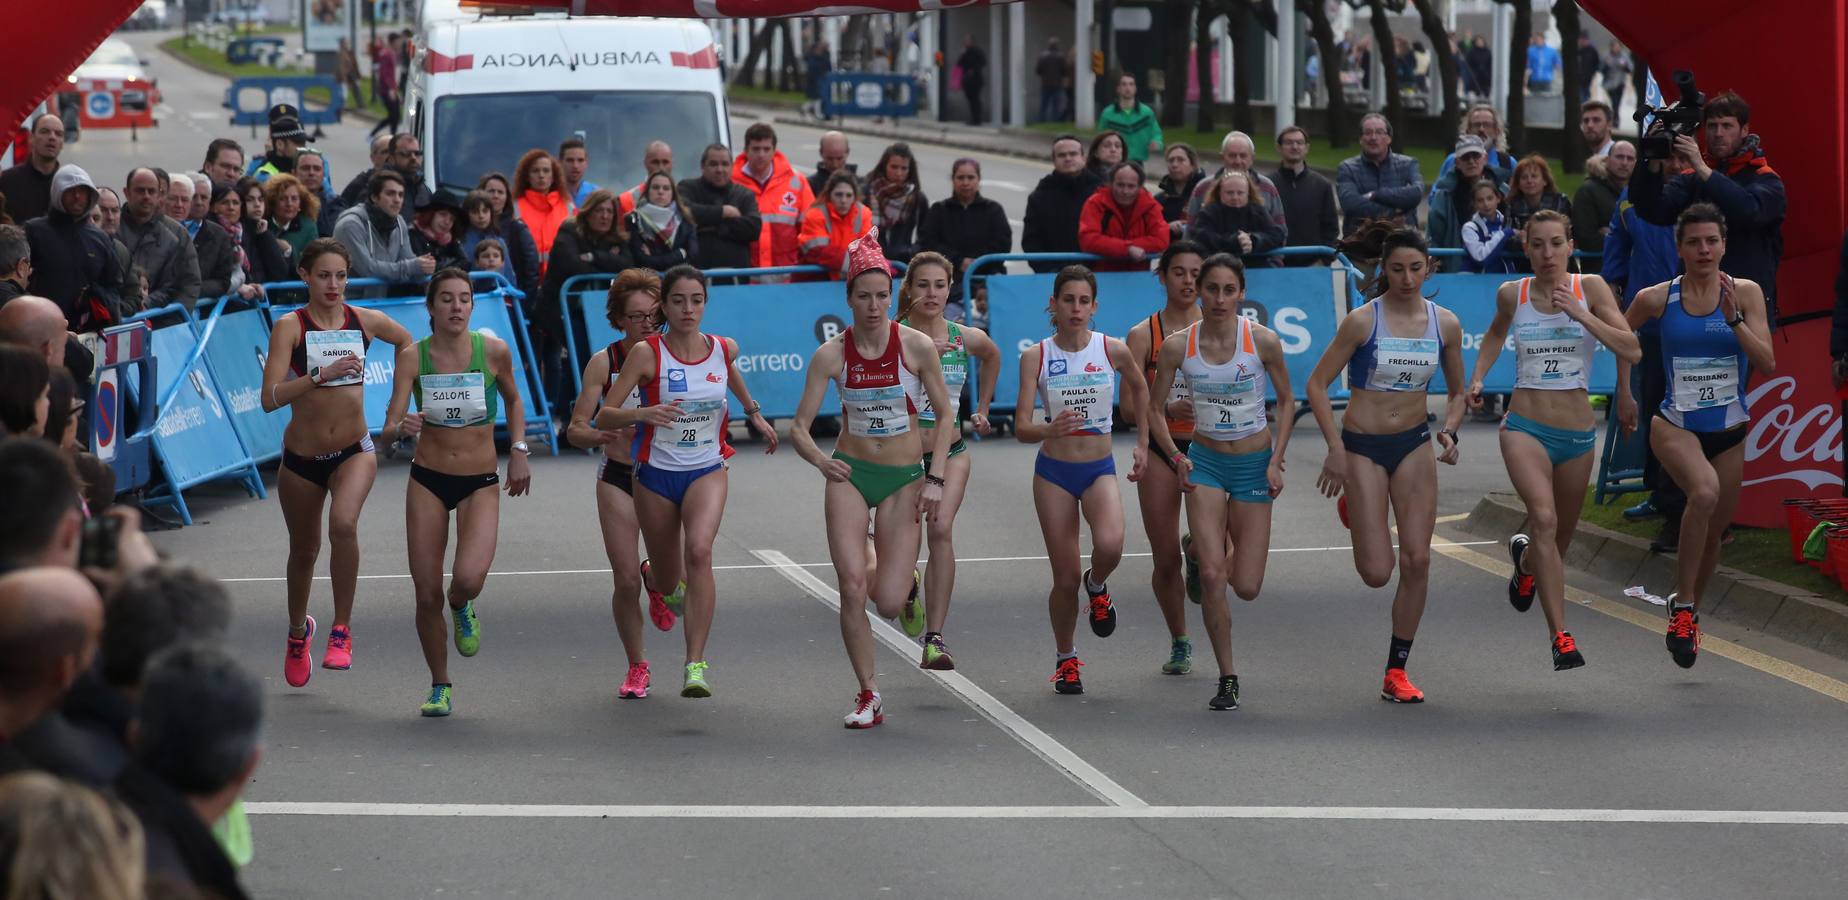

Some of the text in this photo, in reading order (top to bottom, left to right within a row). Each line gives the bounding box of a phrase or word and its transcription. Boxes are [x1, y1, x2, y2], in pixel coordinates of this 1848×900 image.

[1544, 360, 1559, 373] 22
[1398, 371, 1412, 383] 24
[1682, 373, 1728, 382] ESCRIBANO
[432, 391, 470, 401] SALOME
[1061, 388, 1088, 396] PAULA
[1699, 387, 1714, 400] 23
[1064, 398, 1097, 406] BLANCO
[446, 407, 461, 419] 32
[1220, 411, 1231, 423] 21
[681, 429, 696, 441] 28
